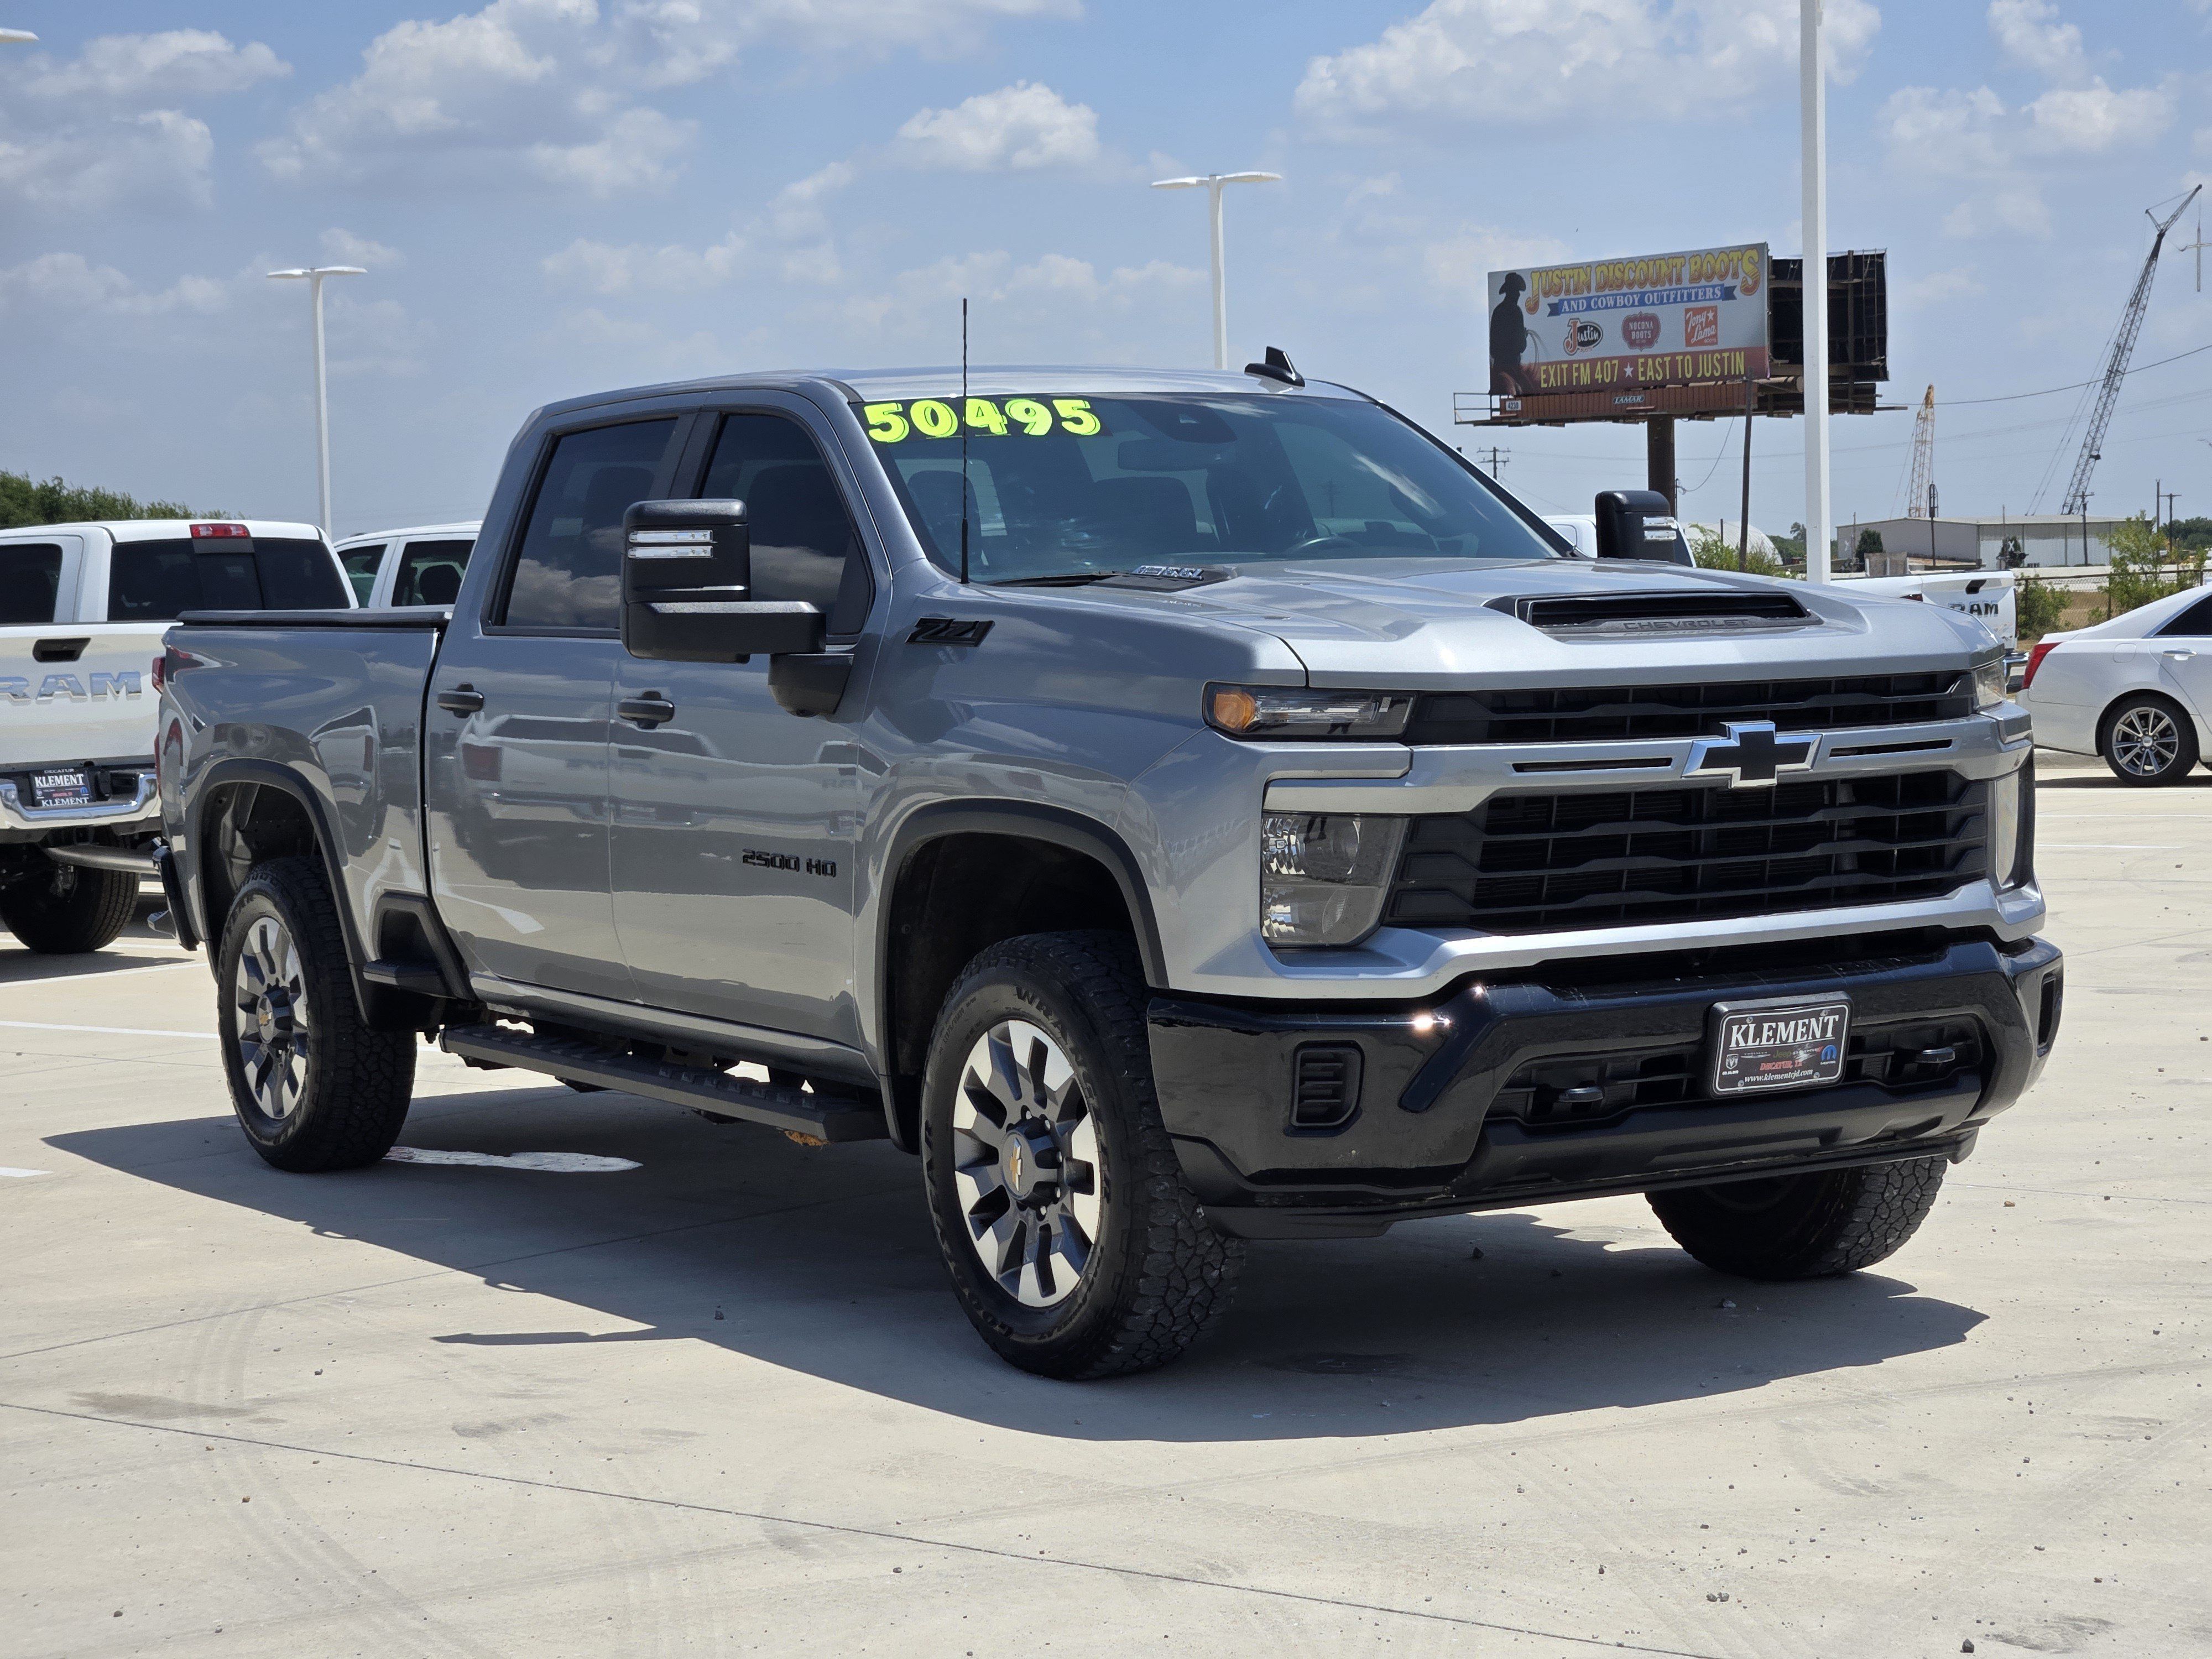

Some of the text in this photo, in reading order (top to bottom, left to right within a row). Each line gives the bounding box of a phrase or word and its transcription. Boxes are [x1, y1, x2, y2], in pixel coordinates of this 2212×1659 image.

[1525, 248, 1760, 315] JUSTIN DISCOUNT BOOTS
[1561, 286, 1721, 312] AND COWBOY OUTFITTERS
[1629, 321, 1653, 331] NOCONA
[1686, 311, 1707, 333] Tony
[1564, 320, 1599, 353] Justin
[1631, 331, 1651, 340] BOOTS
[1691, 324, 1717, 344] Lama
[1541, 351, 1745, 388] EXIT FM 407 EAST TO JUSTIN
[1614, 395, 1642, 404] LAMAR
[864, 398, 1100, 443] 50495
[1623, 619, 1749, 630] CHEVROLET
[35, 774, 85, 787] KLEMENT
[41, 797, 89, 807] KLEMENT
[742, 848, 836, 878] 2500 HD
[1729, 1015, 1839, 1047] KLEMENT
[1745, 1069, 1813, 1082] www.klementcjd.com
